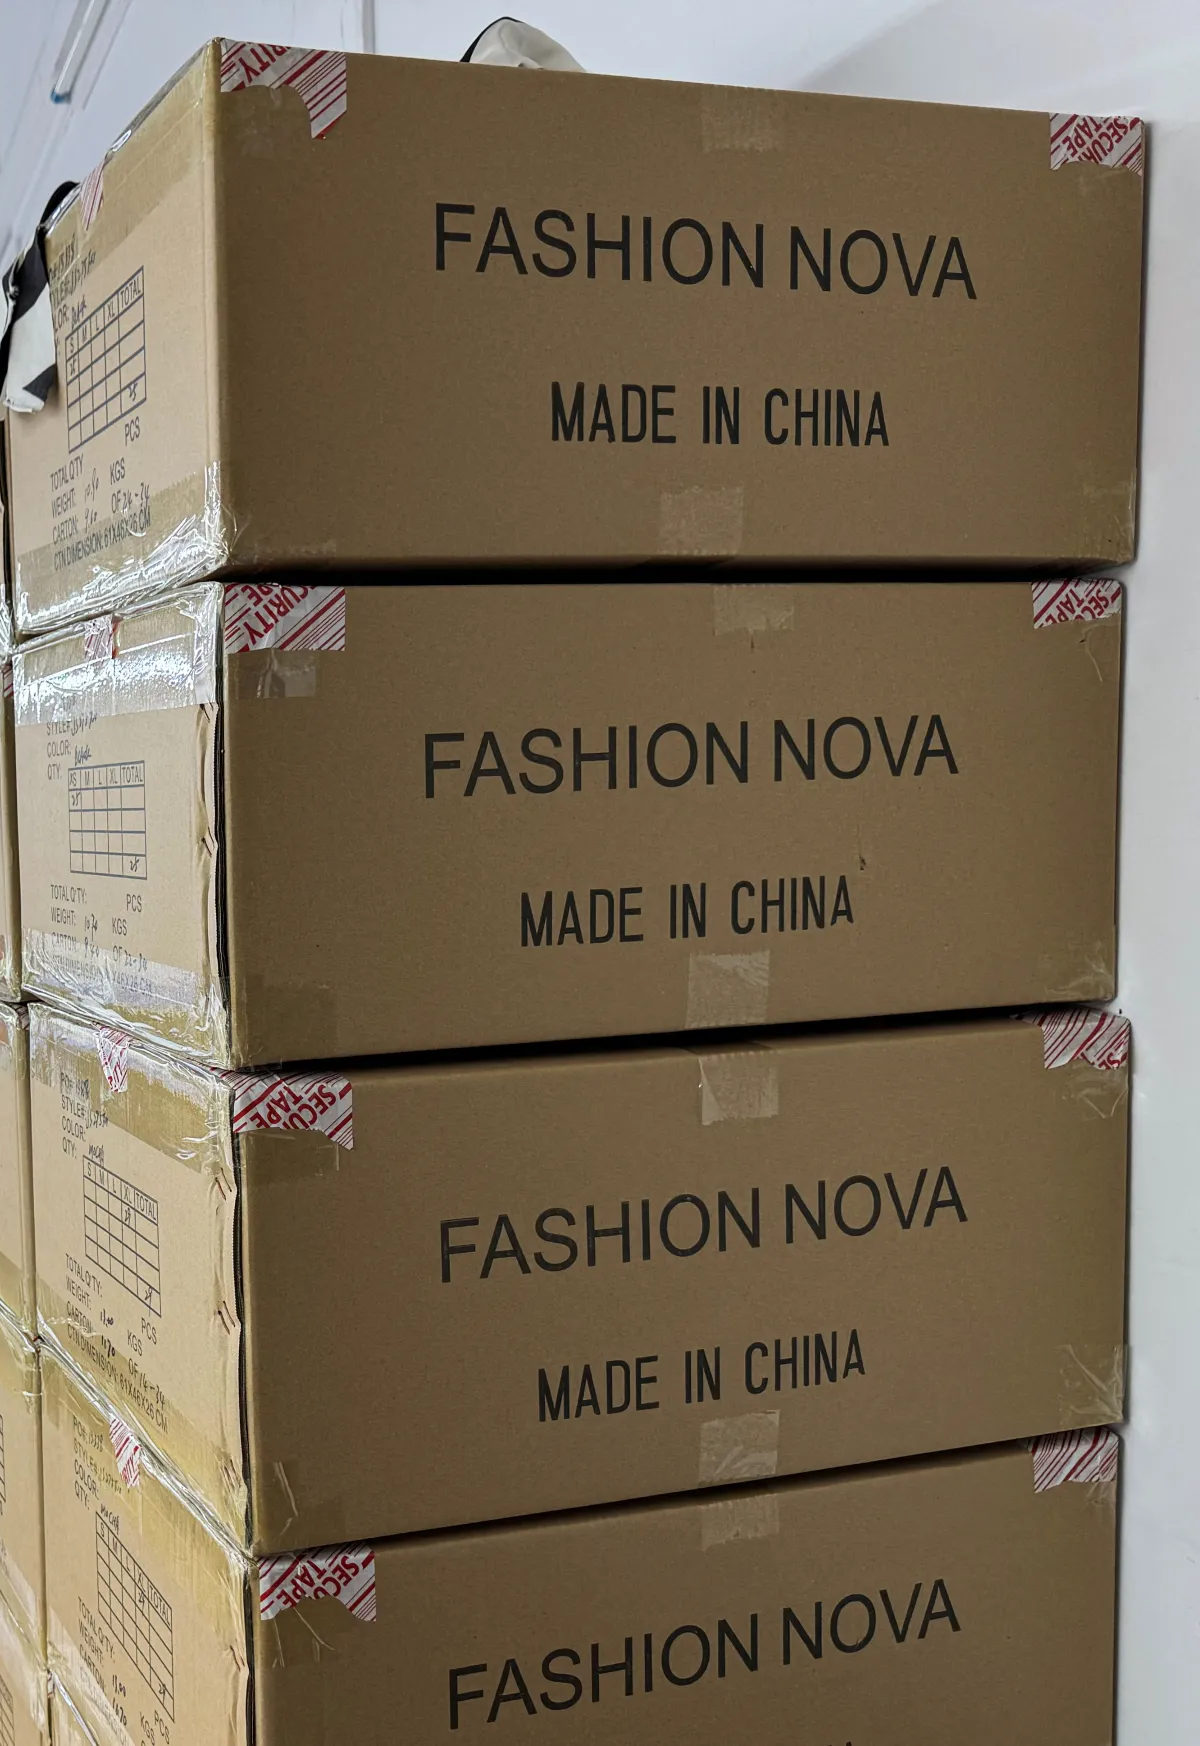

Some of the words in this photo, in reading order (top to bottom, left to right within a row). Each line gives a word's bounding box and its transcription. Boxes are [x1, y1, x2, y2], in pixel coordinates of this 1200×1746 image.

[435, 203, 764, 288] FASHION
[790, 226, 977, 299] NOVA
[106, 297, 115, 321] XL
[119, 273, 141, 310] TOTAL
[552, 381, 676, 443] MADE
[702, 385, 740, 444] IN
[764, 388, 889, 446] CHINA
[50, 461, 70, 493] TOTAL
[124, 414, 141, 446] PCS
[109, 454, 126, 486] KGS
[50, 486, 76, 520] WEIGHT:
[110, 488, 121, 516] OF
[52, 513, 79, 547] CARTON:
[46, 739, 71, 757] COLOR:
[424, 720, 748, 799] FASHION
[773, 714, 959, 782] NOVA
[47, 762, 62, 780] QTY:
[109, 768, 118, 784] XL
[121, 764, 142, 784] TOTAL
[50, 884, 69, 902] TOTAL
[125, 893, 142, 913] PCS
[50, 907, 76, 927] WEIGHT:
[521, 886, 643, 947] MADE
[669, 882, 706, 939] IN
[731, 875, 854, 935] CHINA
[111, 916, 127, 937] KGS
[111, 944, 123, 964] OF
[60, 1093, 86, 1122] STYLE#:
[61, 1114, 86, 1143] COLOR:
[62, 1135, 77, 1159] QTY:
[123, 1184, 132, 1204] XL
[135, 1191, 157, 1221] TOTAL
[440, 1187, 760, 1283] FASHION
[784, 1166, 968, 1243] NOVA
[65, 1274, 91, 1312] WEIGHT:
[65, 1251, 85, 1283] TOTAL
[140, 1316, 157, 1346] PCS
[126, 1329, 143, 1358] KGS
[67, 1320, 81, 1348] CTN
[79, 1331, 119, 1388] DIMENSION:
[119, 1370, 155, 1422] 61X46X26
[154, 1406, 168, 1435] CM
[127, 1356, 139, 1381] OF
[538, 1355, 660, 1422] MADE
[683, 1347, 721, 1404] IN
[744, 1329, 866, 1394] CHINA
[73, 1456, 100, 1503] COLOR:
[74, 1478, 90, 1512] QTY:
[136, 1566, 146, 1594] XL
[148, 1582, 171, 1628] TOTAL
[78, 1616, 103, 1669] WEIGHT:
[449, 1612, 758, 1729] FASHION
[783, 1578, 961, 1665] NOVA
[77, 1593, 97, 1638] TOTAL
[154, 1707, 170, 1746] PCS
[139, 1708, 155, 1746] KGS
